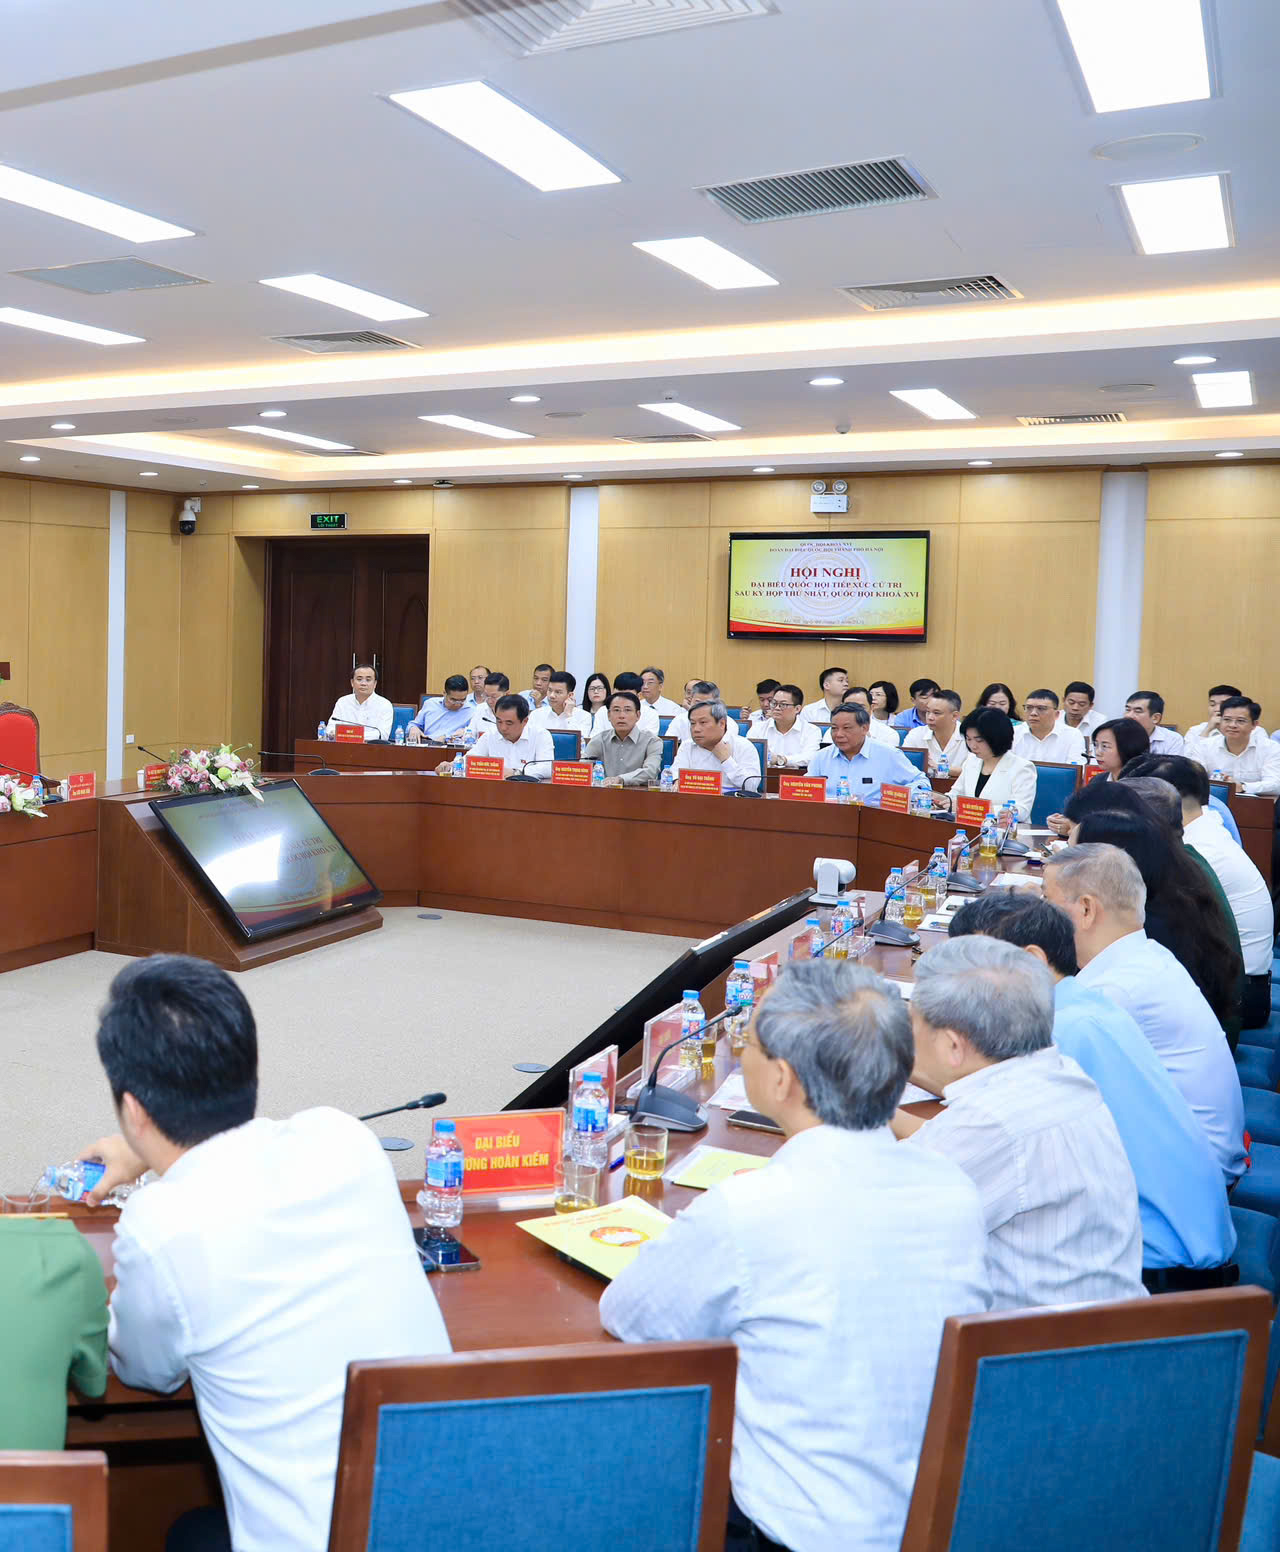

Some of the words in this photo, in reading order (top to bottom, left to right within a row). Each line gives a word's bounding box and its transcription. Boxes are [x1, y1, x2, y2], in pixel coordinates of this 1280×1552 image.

[316, 515, 340, 523] EXIT
[790, 567, 818, 580] HỘI
[822, 567, 861, 580] NGHỊ
[475, 1136, 493, 1152] ĐẠI
[496, 1130, 520, 1149] BIỂU
[490, 1153, 520, 1169] HOÀN
[521, 1150, 550, 1168] KIẾM
